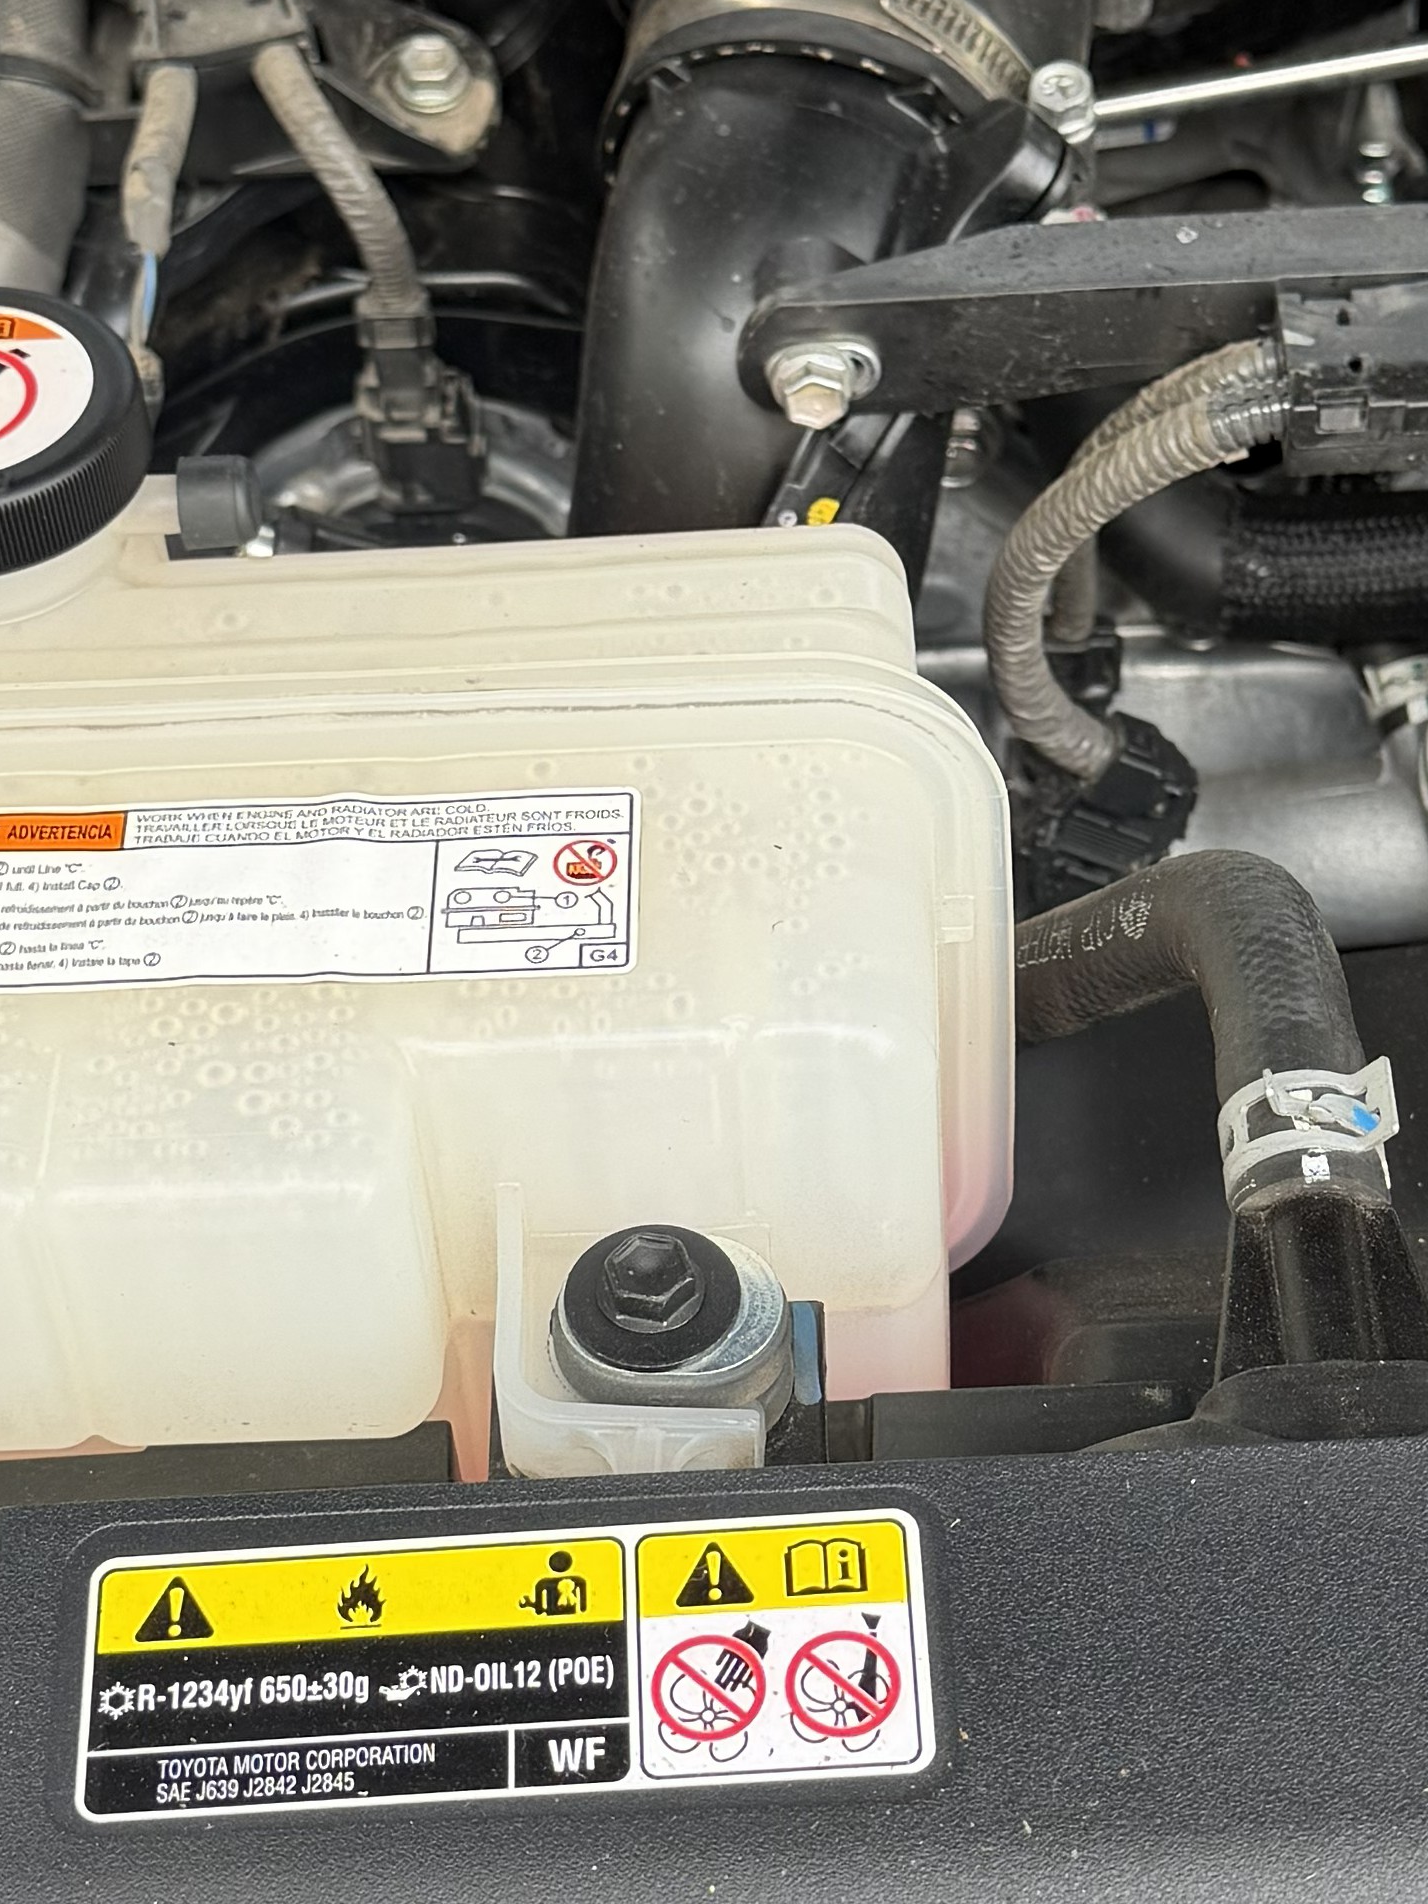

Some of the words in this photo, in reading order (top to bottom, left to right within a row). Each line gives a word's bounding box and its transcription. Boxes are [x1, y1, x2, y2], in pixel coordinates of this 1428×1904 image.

[136, 814, 182, 823] WORK
[297, 807, 327, 817] AND
[331, 805, 407, 818] RADIATOR
[445, 804, 489, 814] COLD.
[136, 821, 223, 833] TRAVAILLER
[226, 821, 296, 831] LORSQUE
[301, 819, 317, 829] LE
[322, 816, 386, 828] MOTEUR
[390, 818, 407, 828] ET
[412, 817, 430, 827] LE
[434, 813, 517, 826] RADIATEUR
[521, 810, 561, 821] SONT
[565, 809, 624, 819] FROIDS.
[7, 824, 112, 840] ADVERTENCIA
[204, 831, 269, 842] CUANDO
[274, 830, 291, 841] EL
[296, 827, 350, 840] MOTOR
[354, 827, 364, 836] Y
[369, 828, 385, 838] EL
[390, 826, 469, 838] RADIADOR
[590, 948, 618, 962] G4
[137, 1677, 254, 1712] R-1234yf
[260, 1671, 370, 1704] 650±30g
[548, 1654, 614, 1693] (POE)
[157, 1755, 229, 1779] TOYOTA
[234, 1751, 300, 1775] MOTOR
[306, 1743, 436, 1770] CORPORATION
[548, 1736, 606, 1773] WF
[156, 1782, 191, 1804] SAE
[196, 1778, 239, 1801] J639
[243, 1776, 296, 1798] J2842
[301, 1771, 355, 1795] J2845
